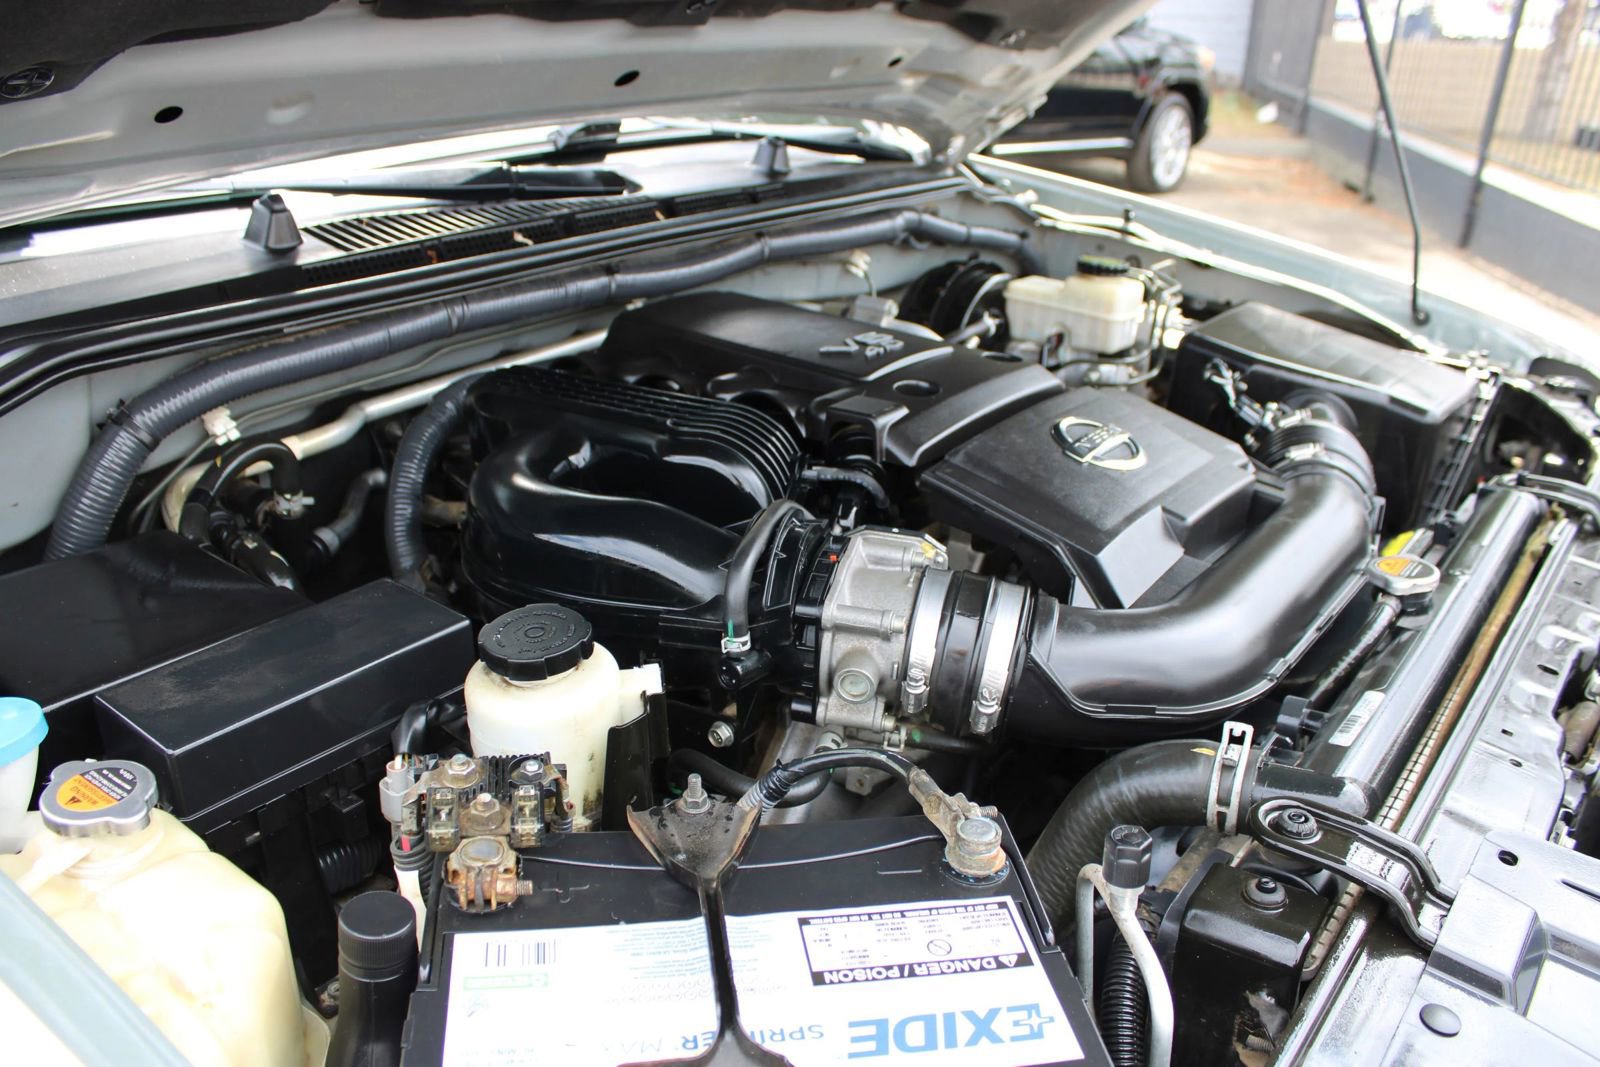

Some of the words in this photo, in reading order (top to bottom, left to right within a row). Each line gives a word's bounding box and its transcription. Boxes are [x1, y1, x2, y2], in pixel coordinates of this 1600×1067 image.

[823, 966, 900, 984] POISON
[914, 957, 997, 977] DANGER
[681, 1024, 825, 1051] SPRIER
[848, 1003, 1053, 1060] EXIDE
